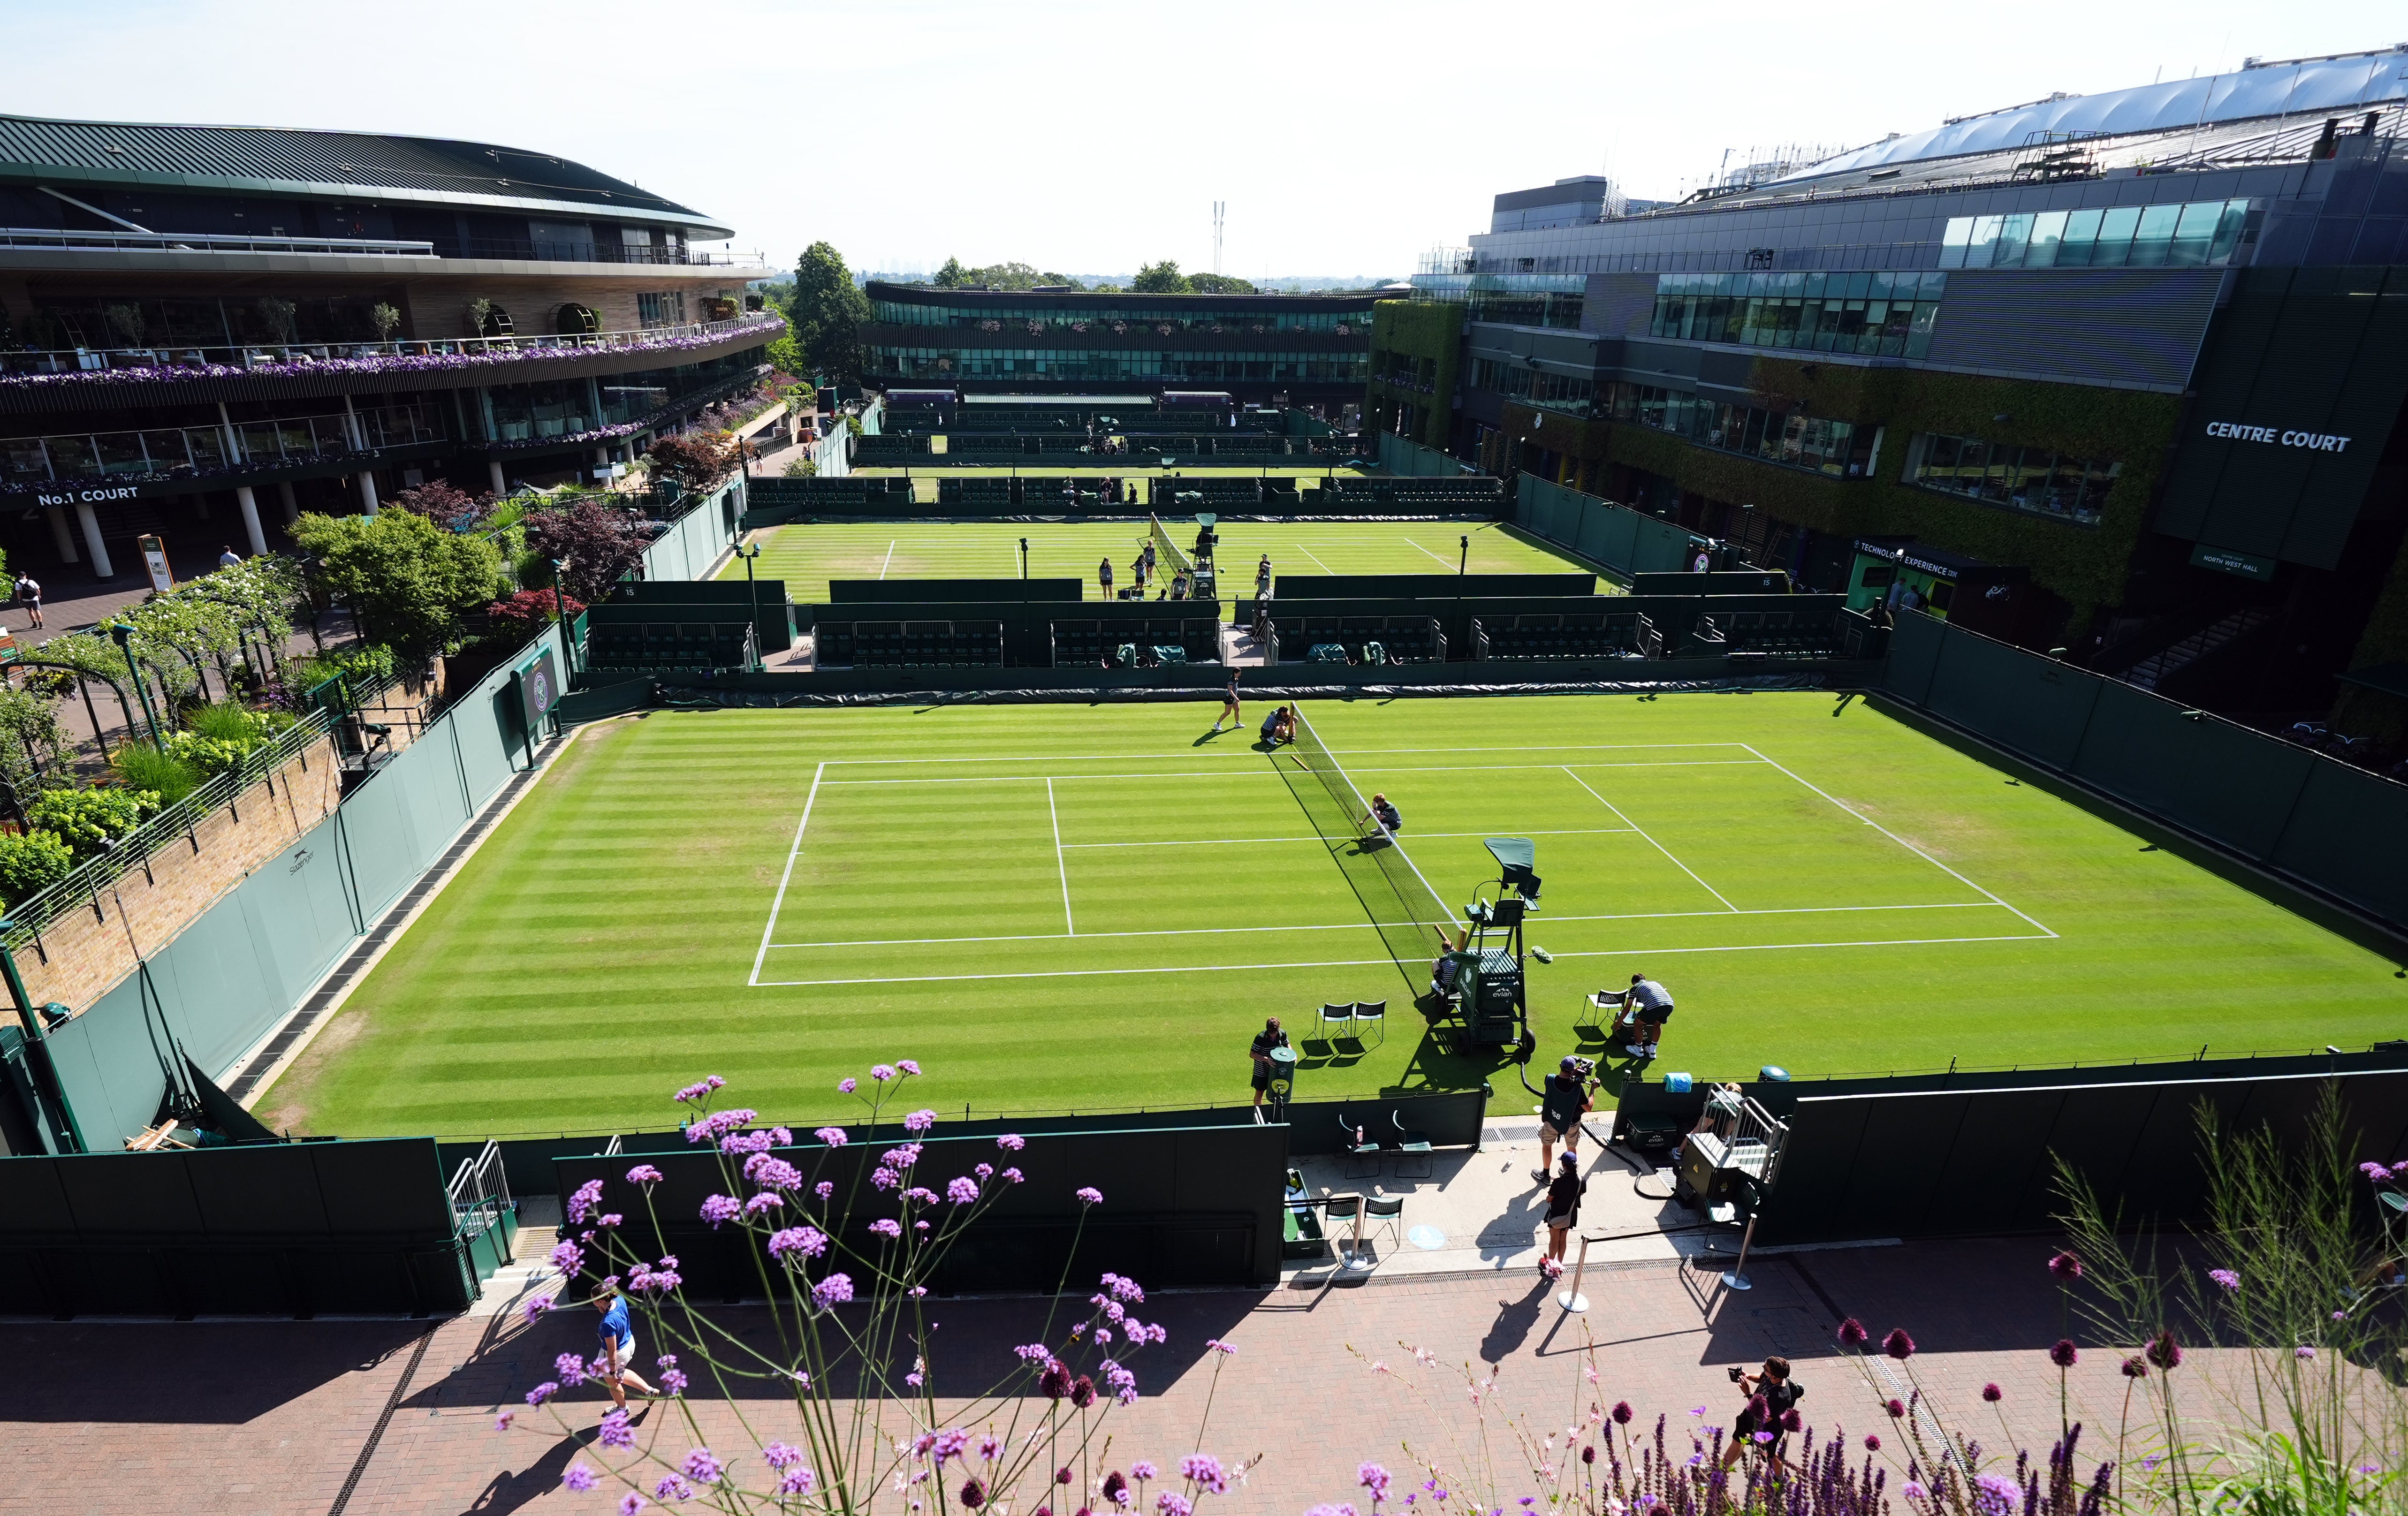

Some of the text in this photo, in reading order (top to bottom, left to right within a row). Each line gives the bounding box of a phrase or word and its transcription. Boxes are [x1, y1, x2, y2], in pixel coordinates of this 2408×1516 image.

[2206, 422, 2352, 452] CENTRE COURT
[38, 487, 138, 506] No.1 COURT
[1861, 542, 1958, 578] TECHNOLOY EXPERIENCE IBM
[2203, 555, 2224, 564] NORTH
[1787, 568, 1798, 576] 2025
[289, 850, 314, 876] Slazenger
[1459, 978, 1472, 998] BARCLAYS
